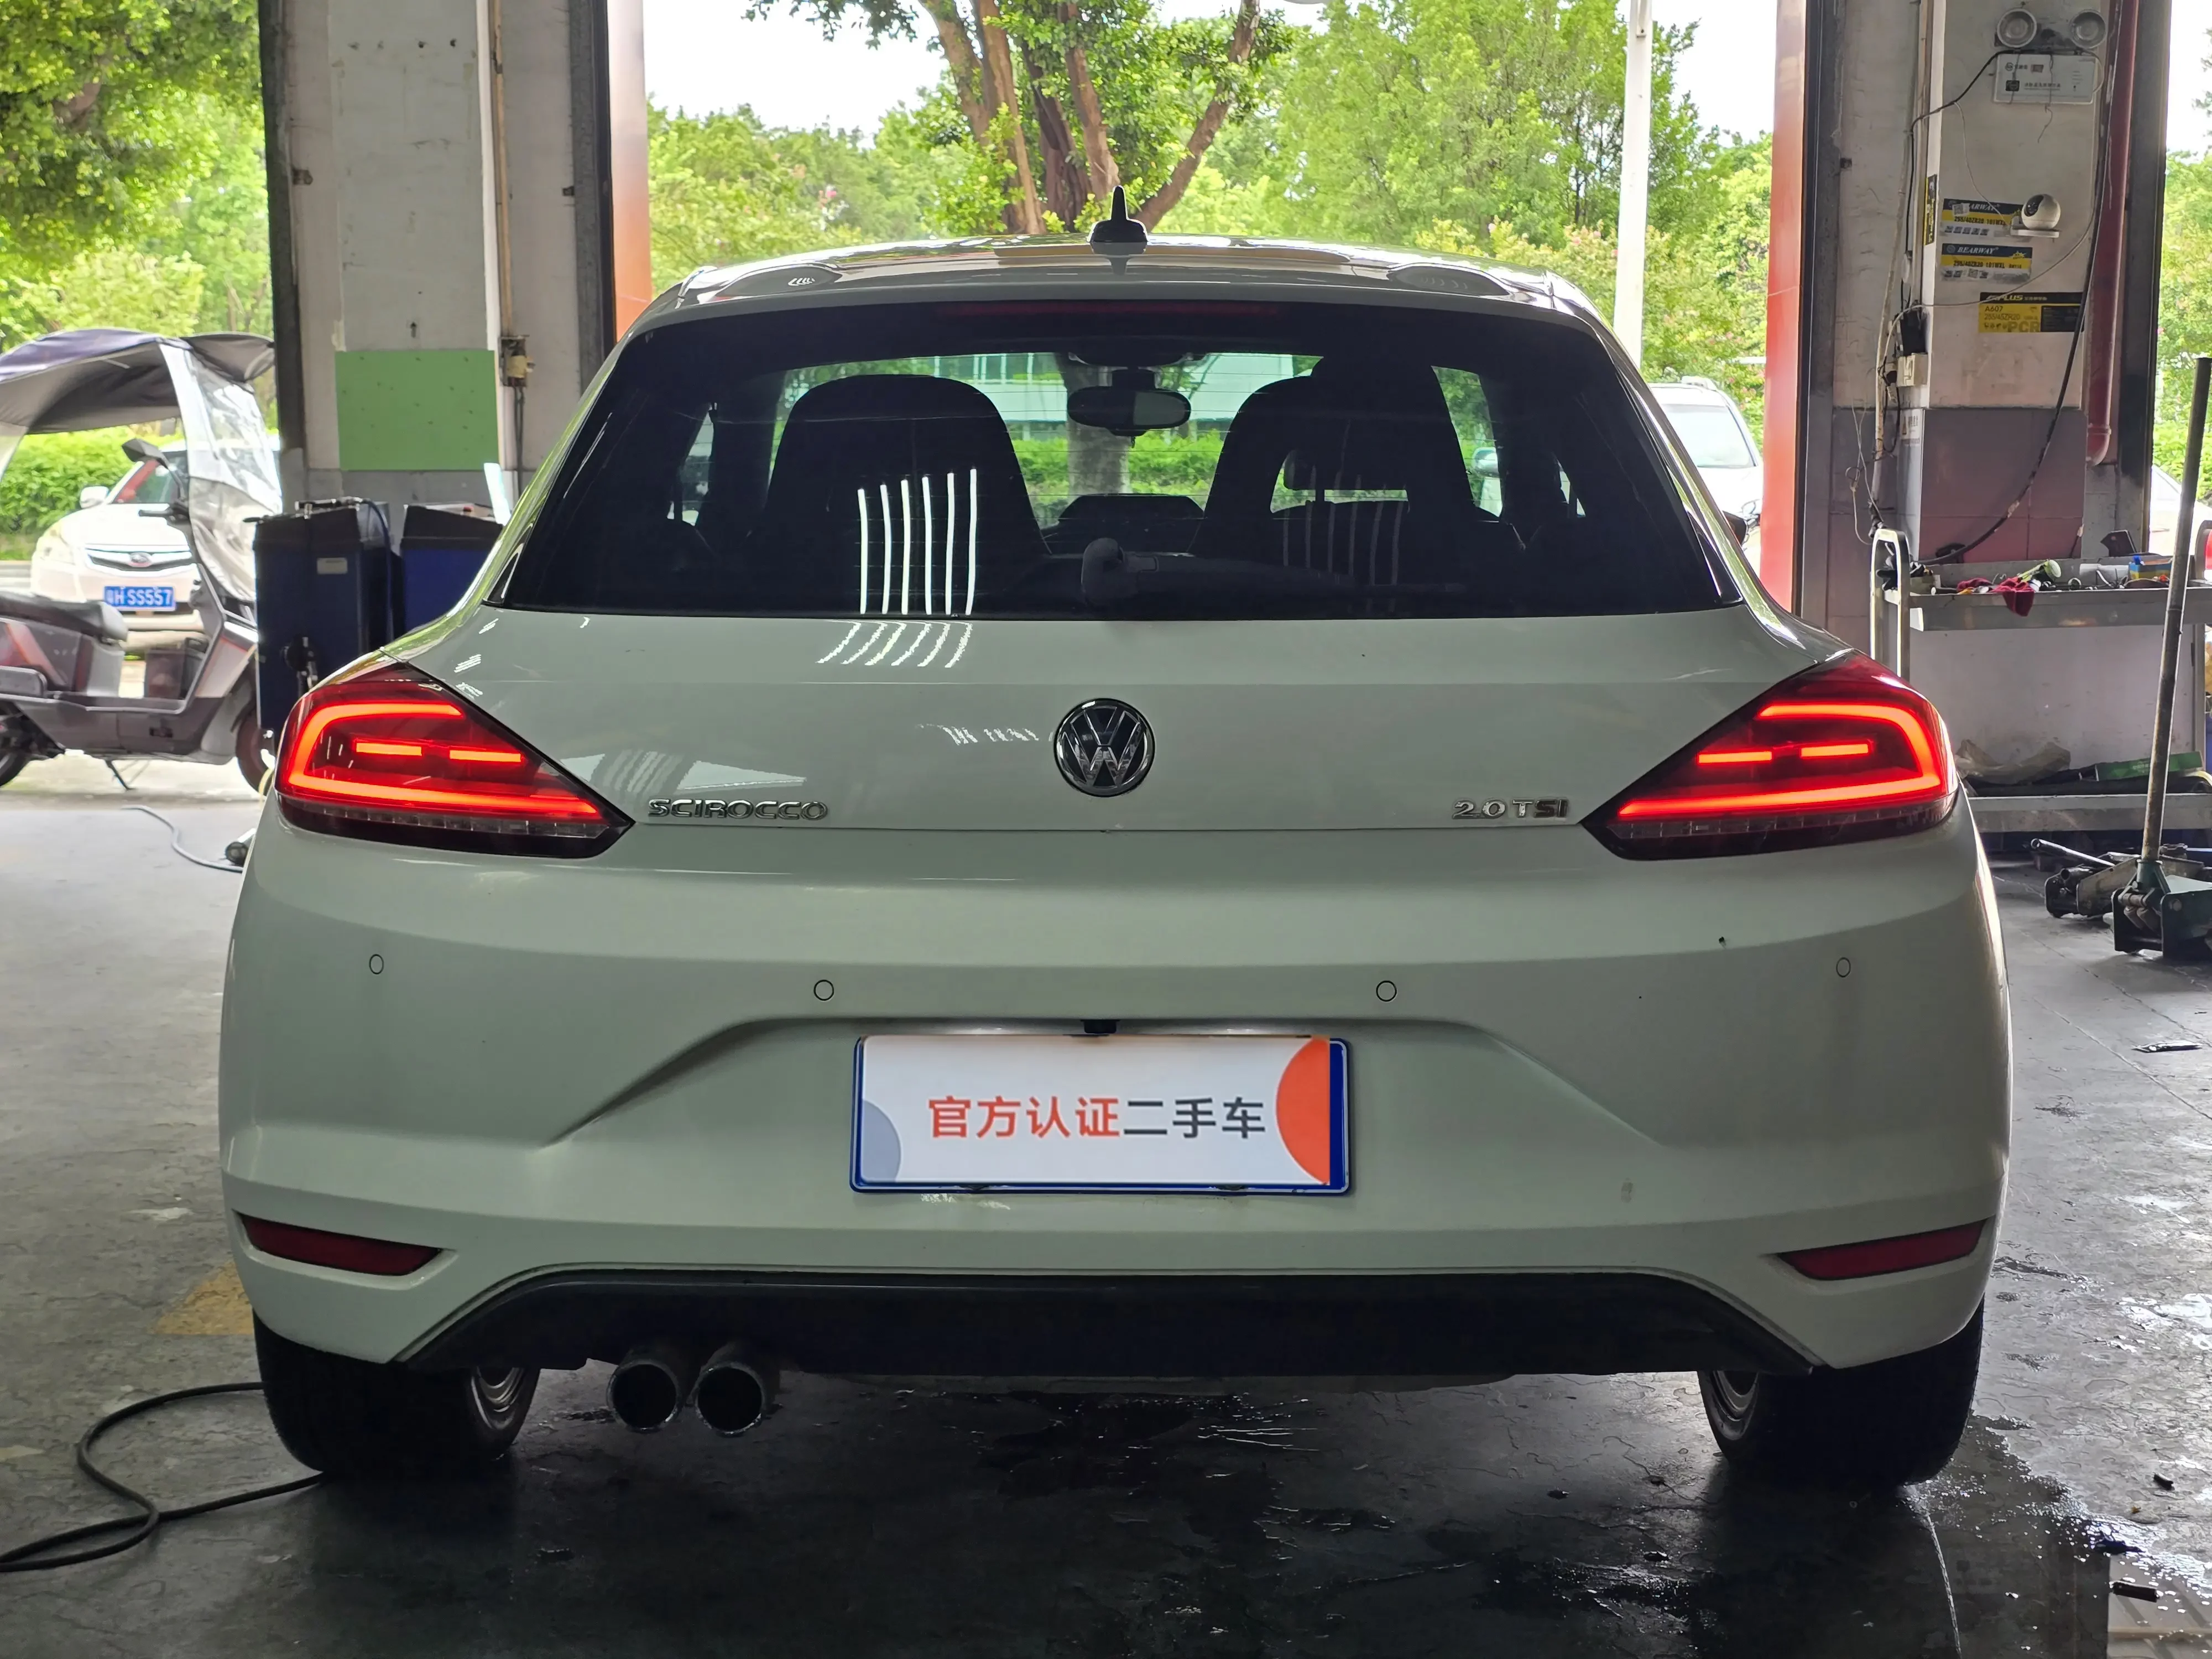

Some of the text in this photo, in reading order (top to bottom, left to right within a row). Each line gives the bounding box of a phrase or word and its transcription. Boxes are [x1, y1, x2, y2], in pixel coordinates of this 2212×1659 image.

[2007, 321, 2040, 332] PCR
[648, 799, 828, 821] SCIROCCO
[929, 1095, 1265, 1139] 官方认证二手车
